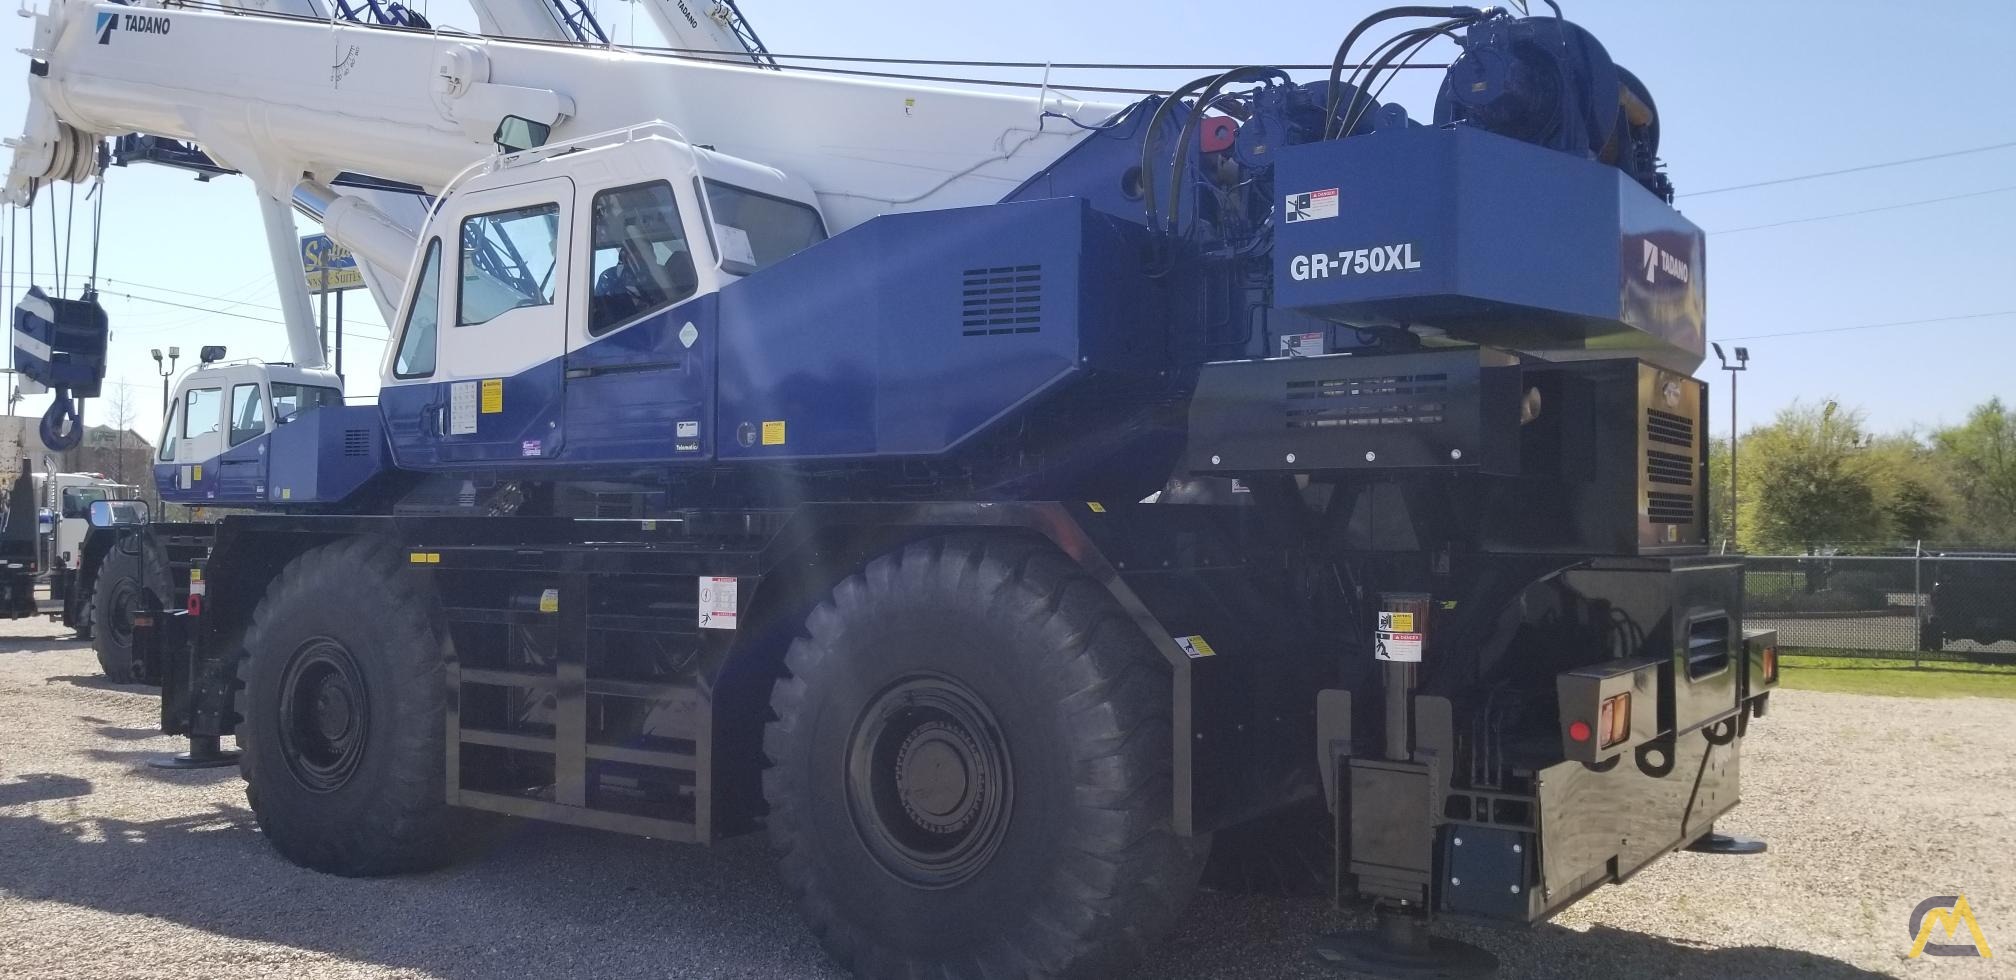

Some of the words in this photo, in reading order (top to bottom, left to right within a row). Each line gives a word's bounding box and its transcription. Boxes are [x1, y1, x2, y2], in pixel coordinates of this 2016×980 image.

[125, 14, 171, 35] TADANO
[677, 0, 697, 28] TADANO
[1290, 243, 1421, 281] GR-750XL
[1661, 249, 1688, 283] TADANO
